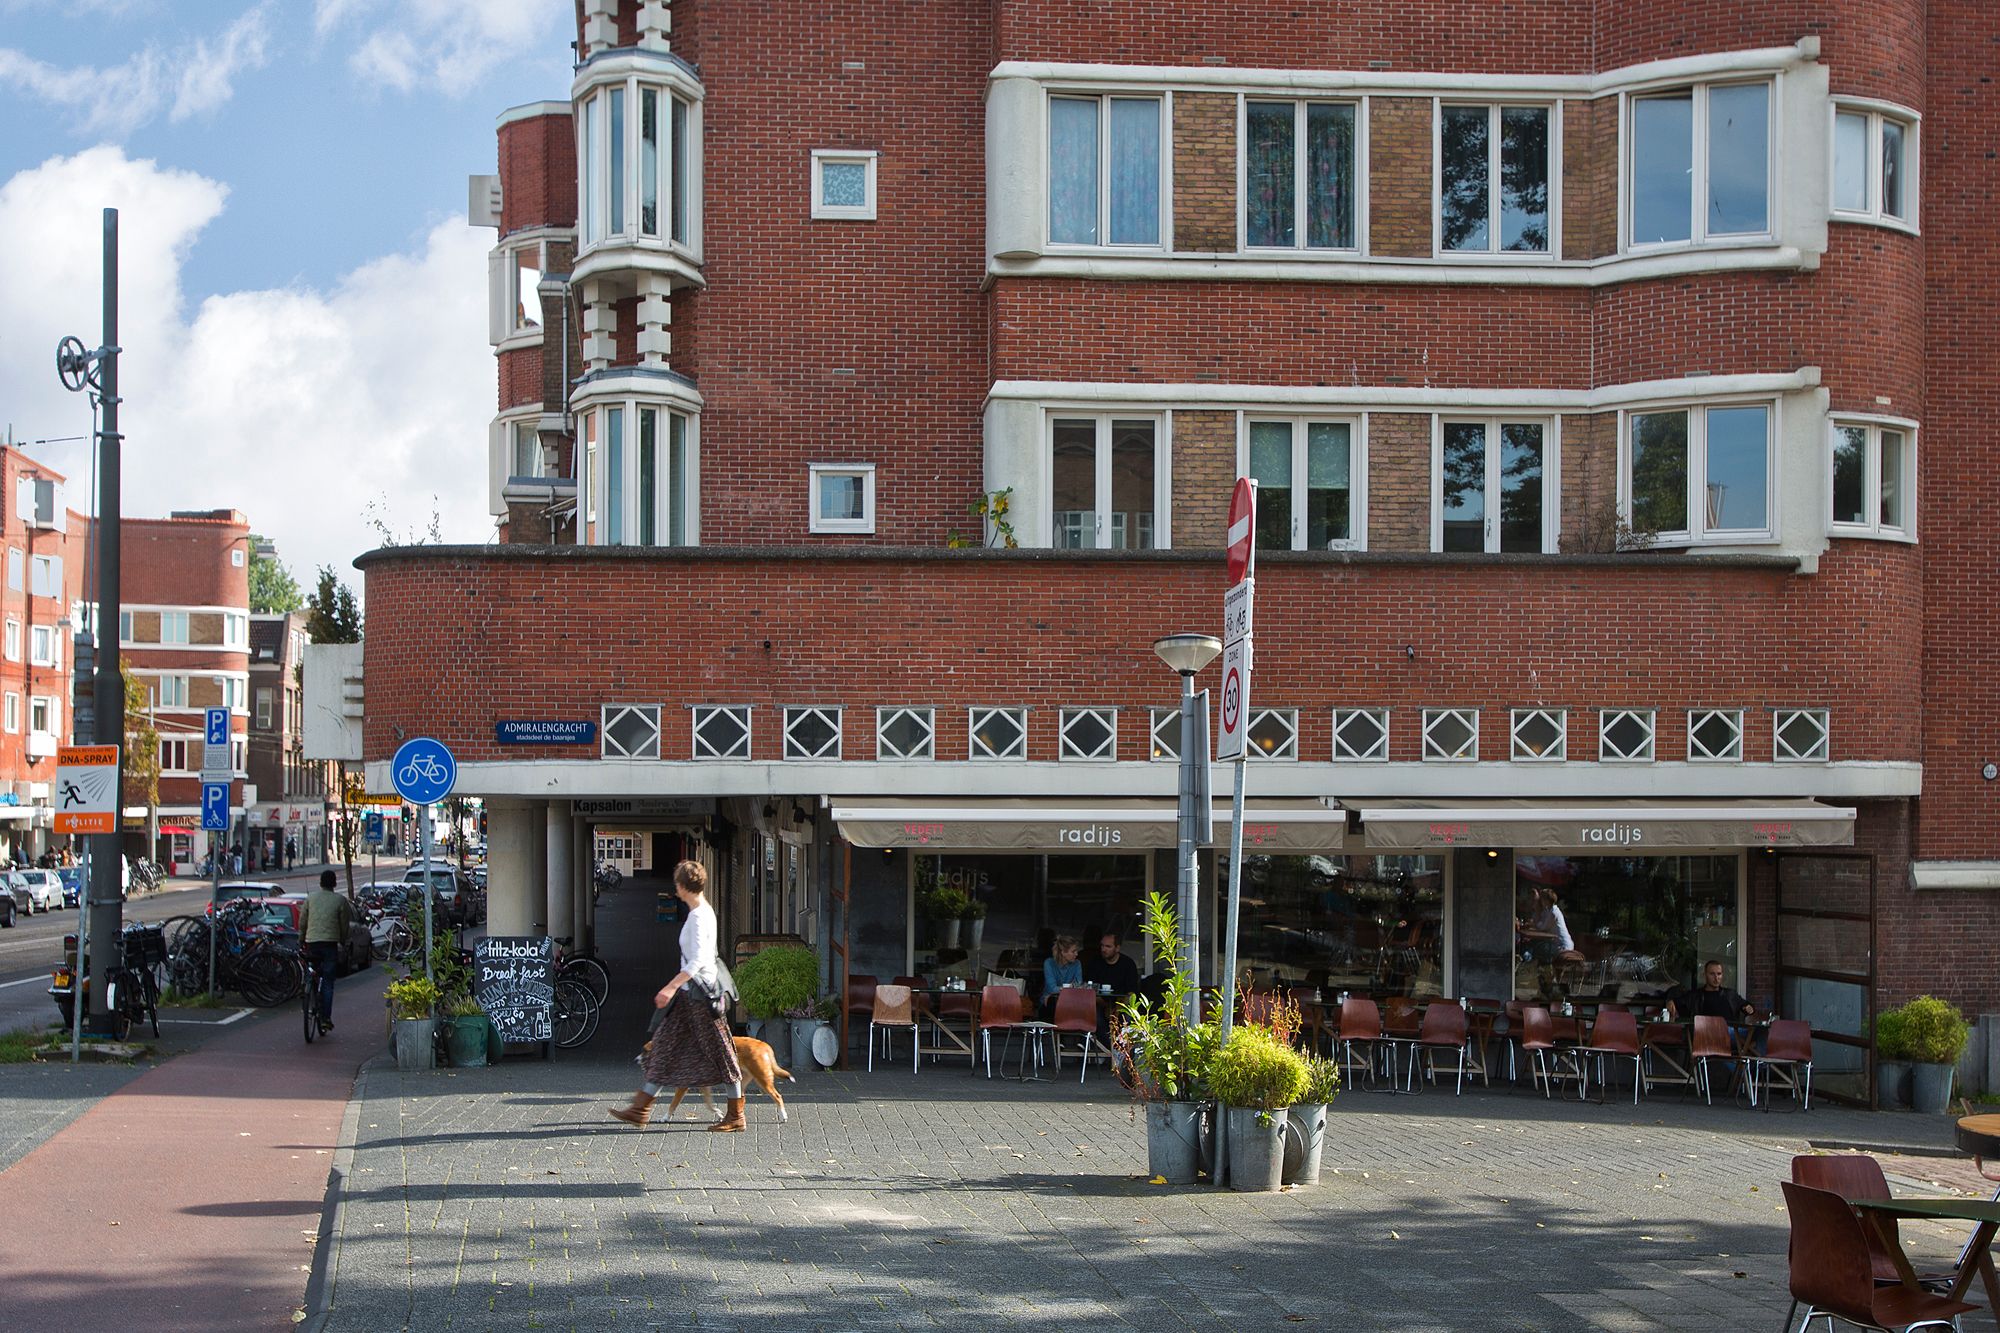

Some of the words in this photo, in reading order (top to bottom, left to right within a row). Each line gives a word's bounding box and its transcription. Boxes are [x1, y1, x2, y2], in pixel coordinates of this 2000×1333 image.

[1228, 648, 1239, 663] ZONE
[1226, 688, 1238, 712] 30
[211, 711, 224, 731] P
[504, 723, 588, 733] ADMIRALENGRACHT
[552, 734, 576, 742] baarsjes
[60, 755, 113, 764] DNA-SPRAY
[208, 786, 223, 809] P
[574, 799, 632, 814] Kapsalon
[65, 815, 103, 828] POLITIE
[904, 823, 944, 834] VEDETT
[1059, 824, 1121, 847] radijs
[1243, 824, 1279, 835] EDETT
[1582, 822, 1642, 845] radijs
[928, 866, 989, 890] radijs
[487, 941, 538, 957] fritz-kola
[504, 1016, 516, 1026] TO
[513, 1008, 525, 1019] GO
